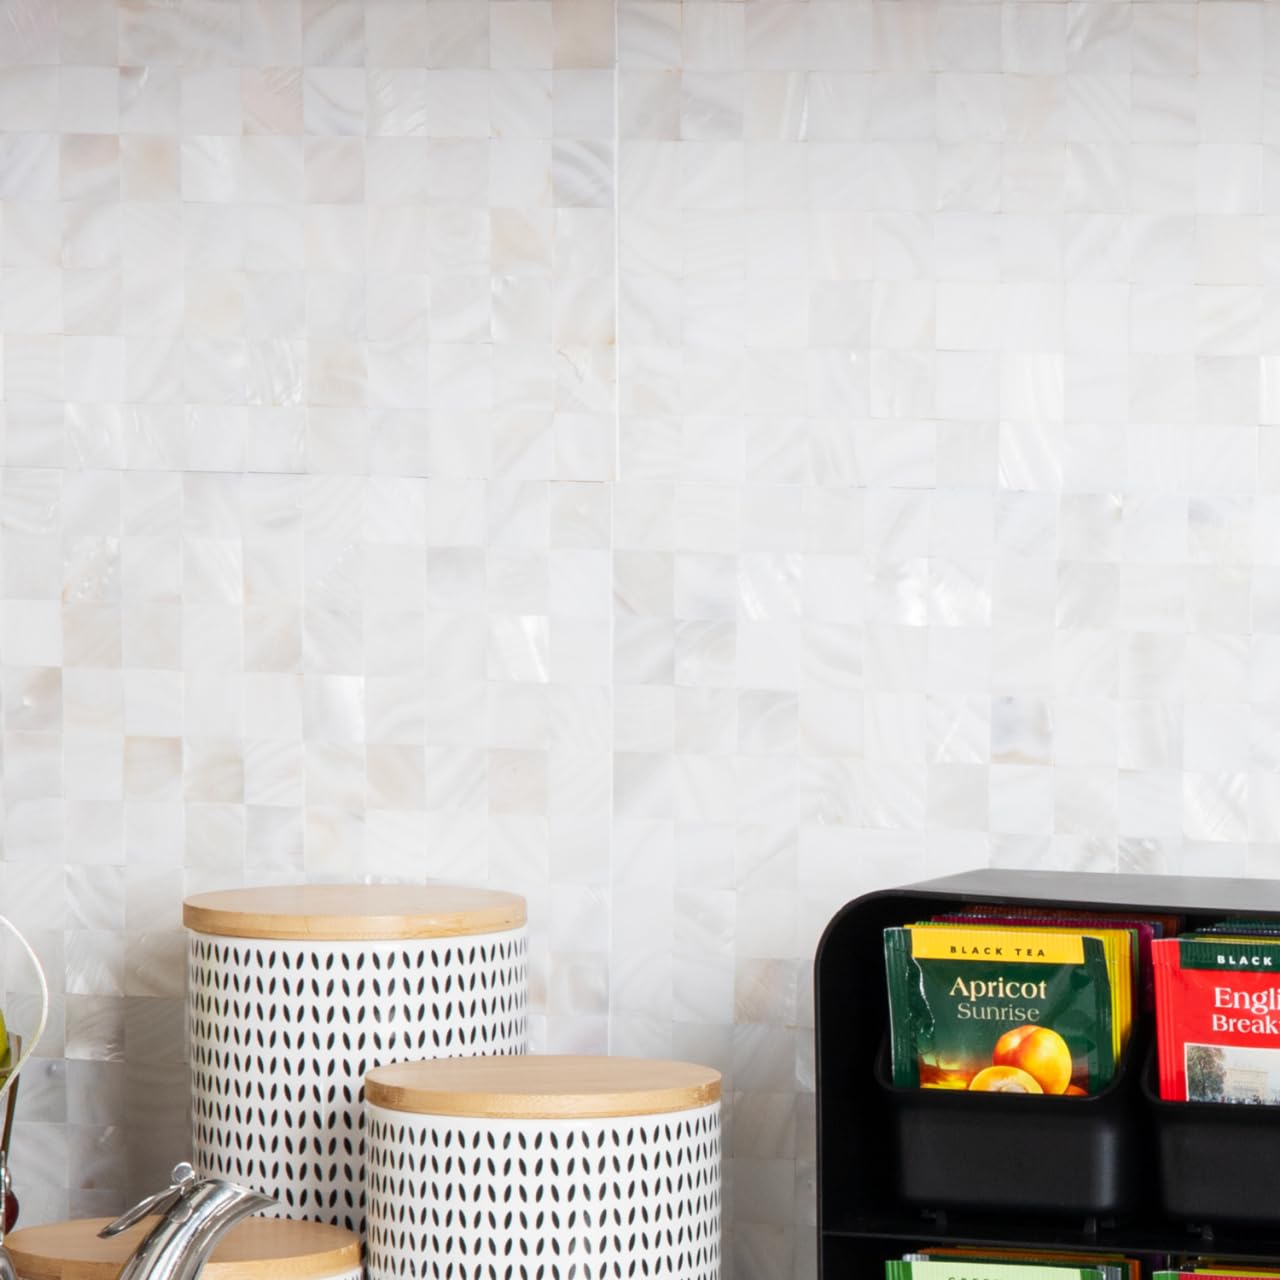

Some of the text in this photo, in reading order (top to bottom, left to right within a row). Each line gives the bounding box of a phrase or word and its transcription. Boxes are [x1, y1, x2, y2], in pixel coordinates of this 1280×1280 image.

[950, 945, 1046, 957] BLACK TEA
[1217, 955, 1272, 966] BLACK
[949, 976, 1047, 1001] Apricot
[957, 1002, 1040, 1022] Sunrise
